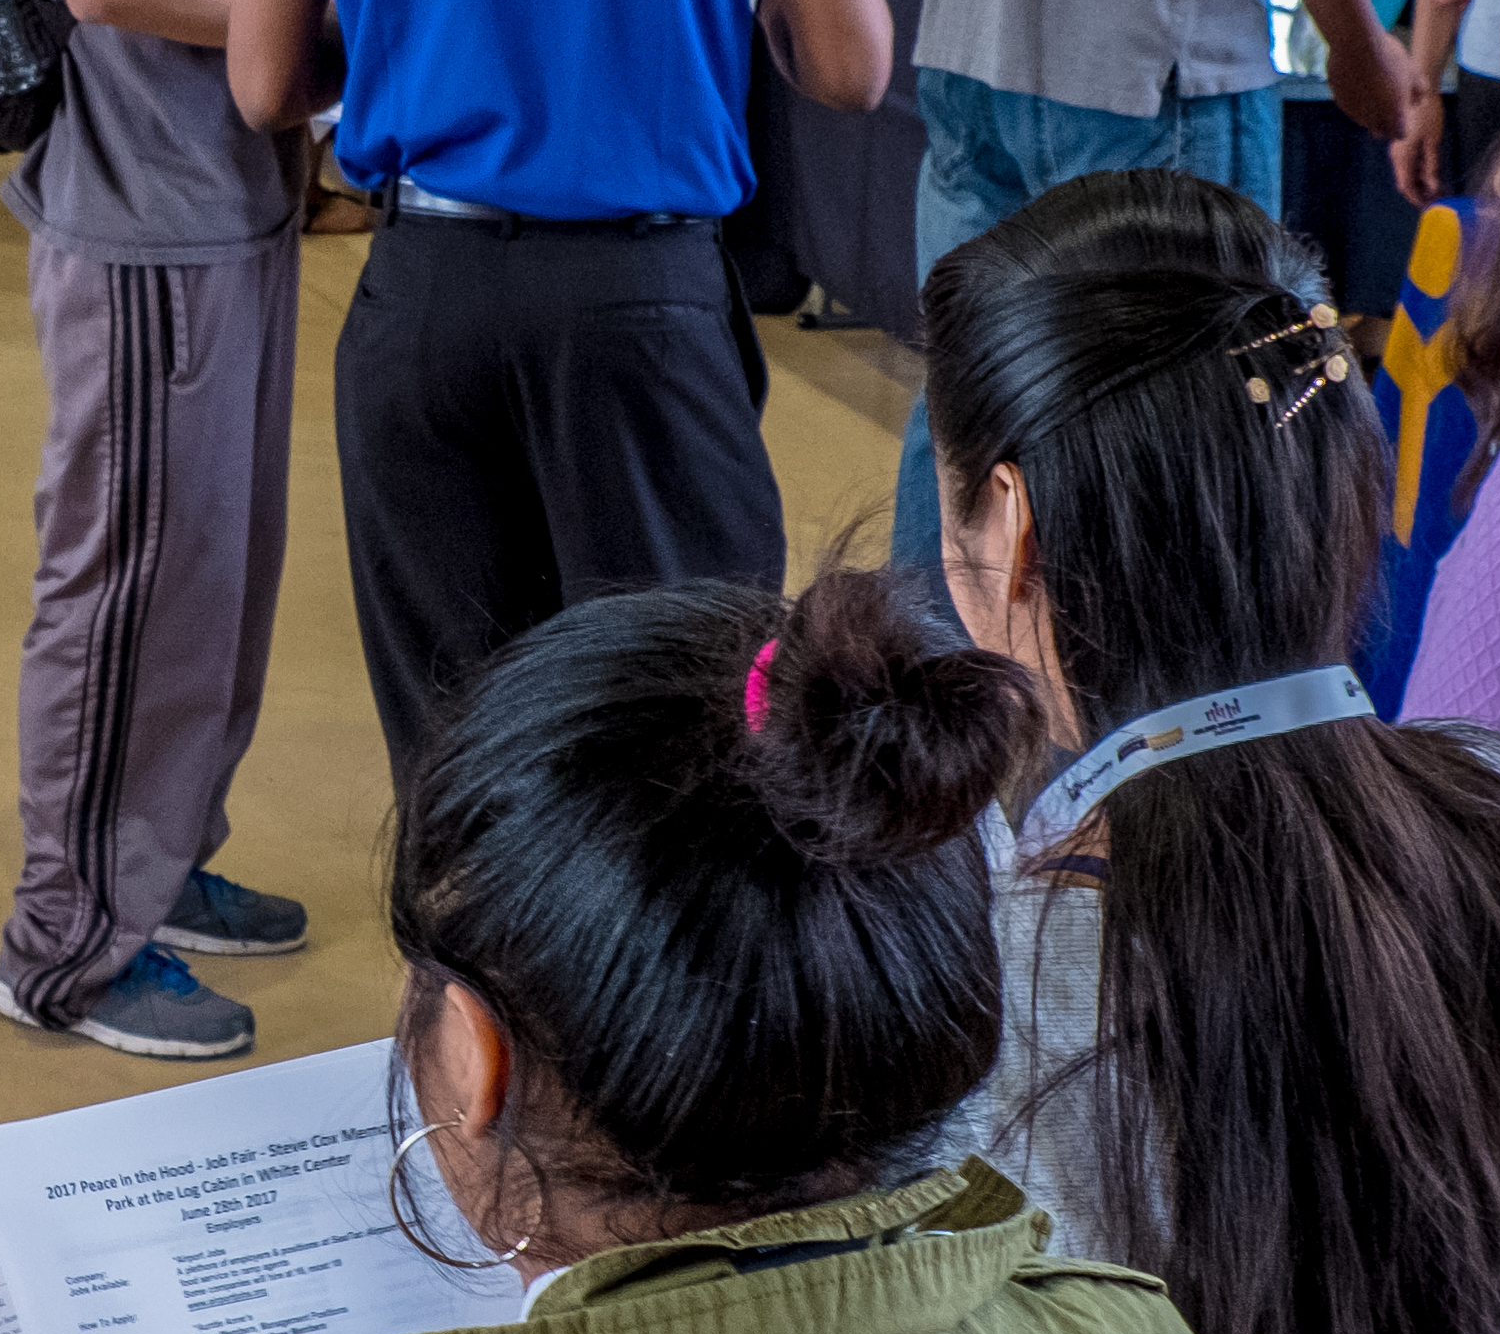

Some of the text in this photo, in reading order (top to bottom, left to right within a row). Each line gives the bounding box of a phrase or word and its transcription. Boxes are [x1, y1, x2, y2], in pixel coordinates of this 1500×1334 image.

[45, 1182, 77, 1200] 2017
[80, 1177, 118, 1194] Peace
[119, 1173, 133, 1187] in
[134, 1170, 157, 1184] the
[158, 1160, 195, 1179] Hood
[205, 1154, 229, 1170] Job
[230, 1149, 257, 1165] Fair
[267, 1140, 308, 1157] Steve
[311, 1134, 339, 1149] Cox
[105, 1154, 353, 1212] Park at the Log Cabin in White Center
[180, 1189, 278, 1222] June 28th 2017
[205, 1215, 262, 1234] Employers
